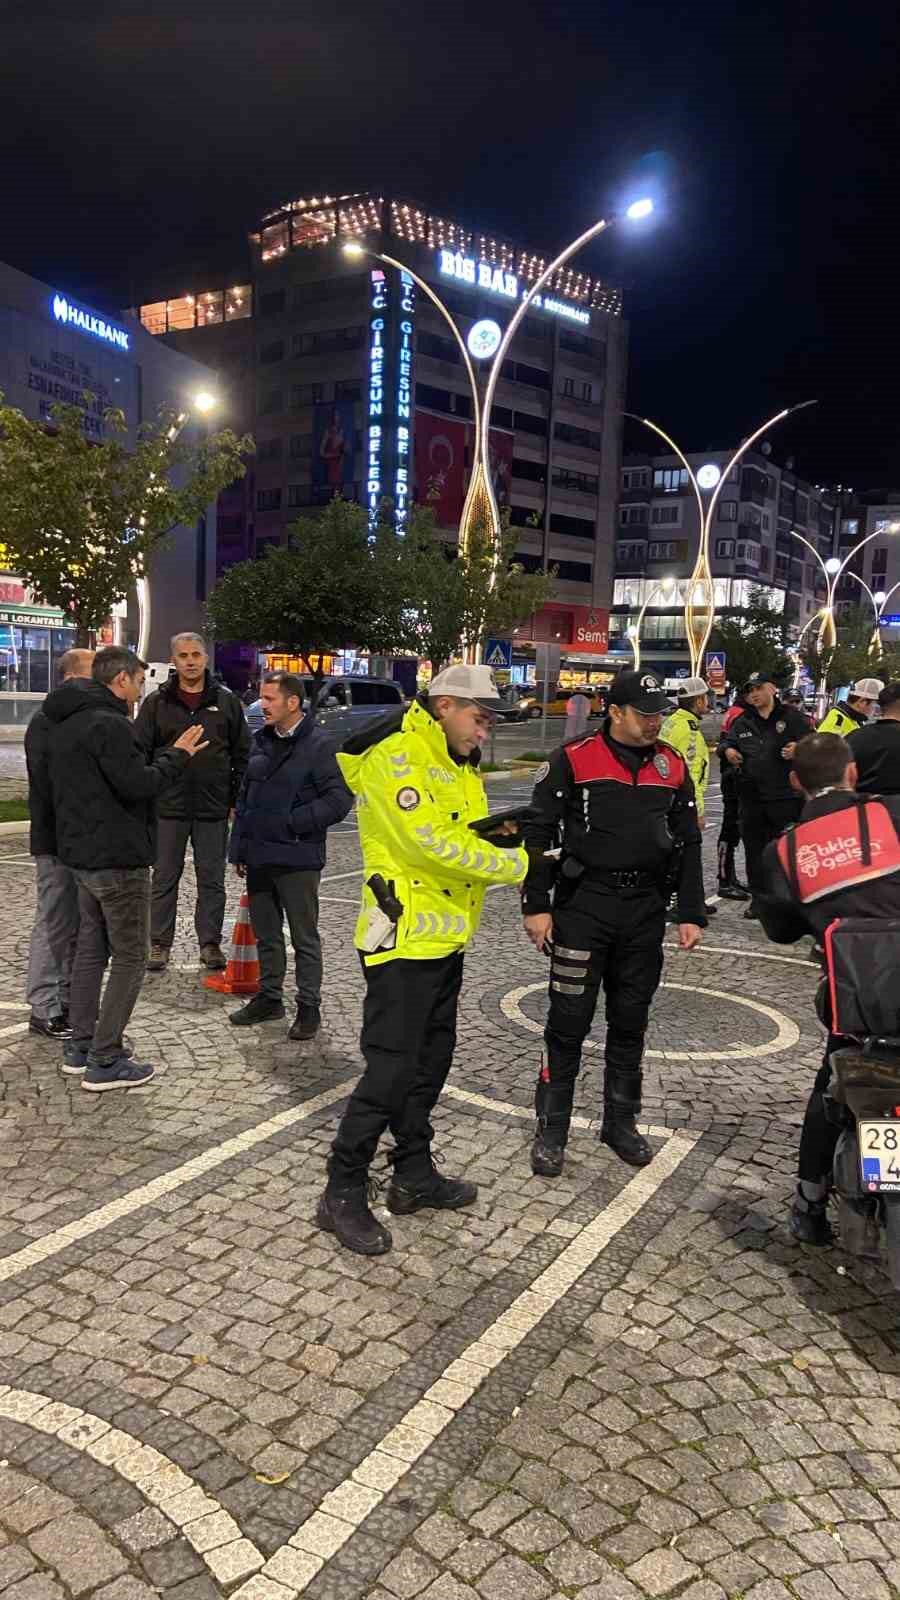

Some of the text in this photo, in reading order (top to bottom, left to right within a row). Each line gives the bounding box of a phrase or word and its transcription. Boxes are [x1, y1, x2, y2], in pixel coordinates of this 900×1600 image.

[68, 305, 129, 349] HALKBANK
[12, 614, 64, 626] LOKANTASI
[866, 1128, 898, 1150] 28
